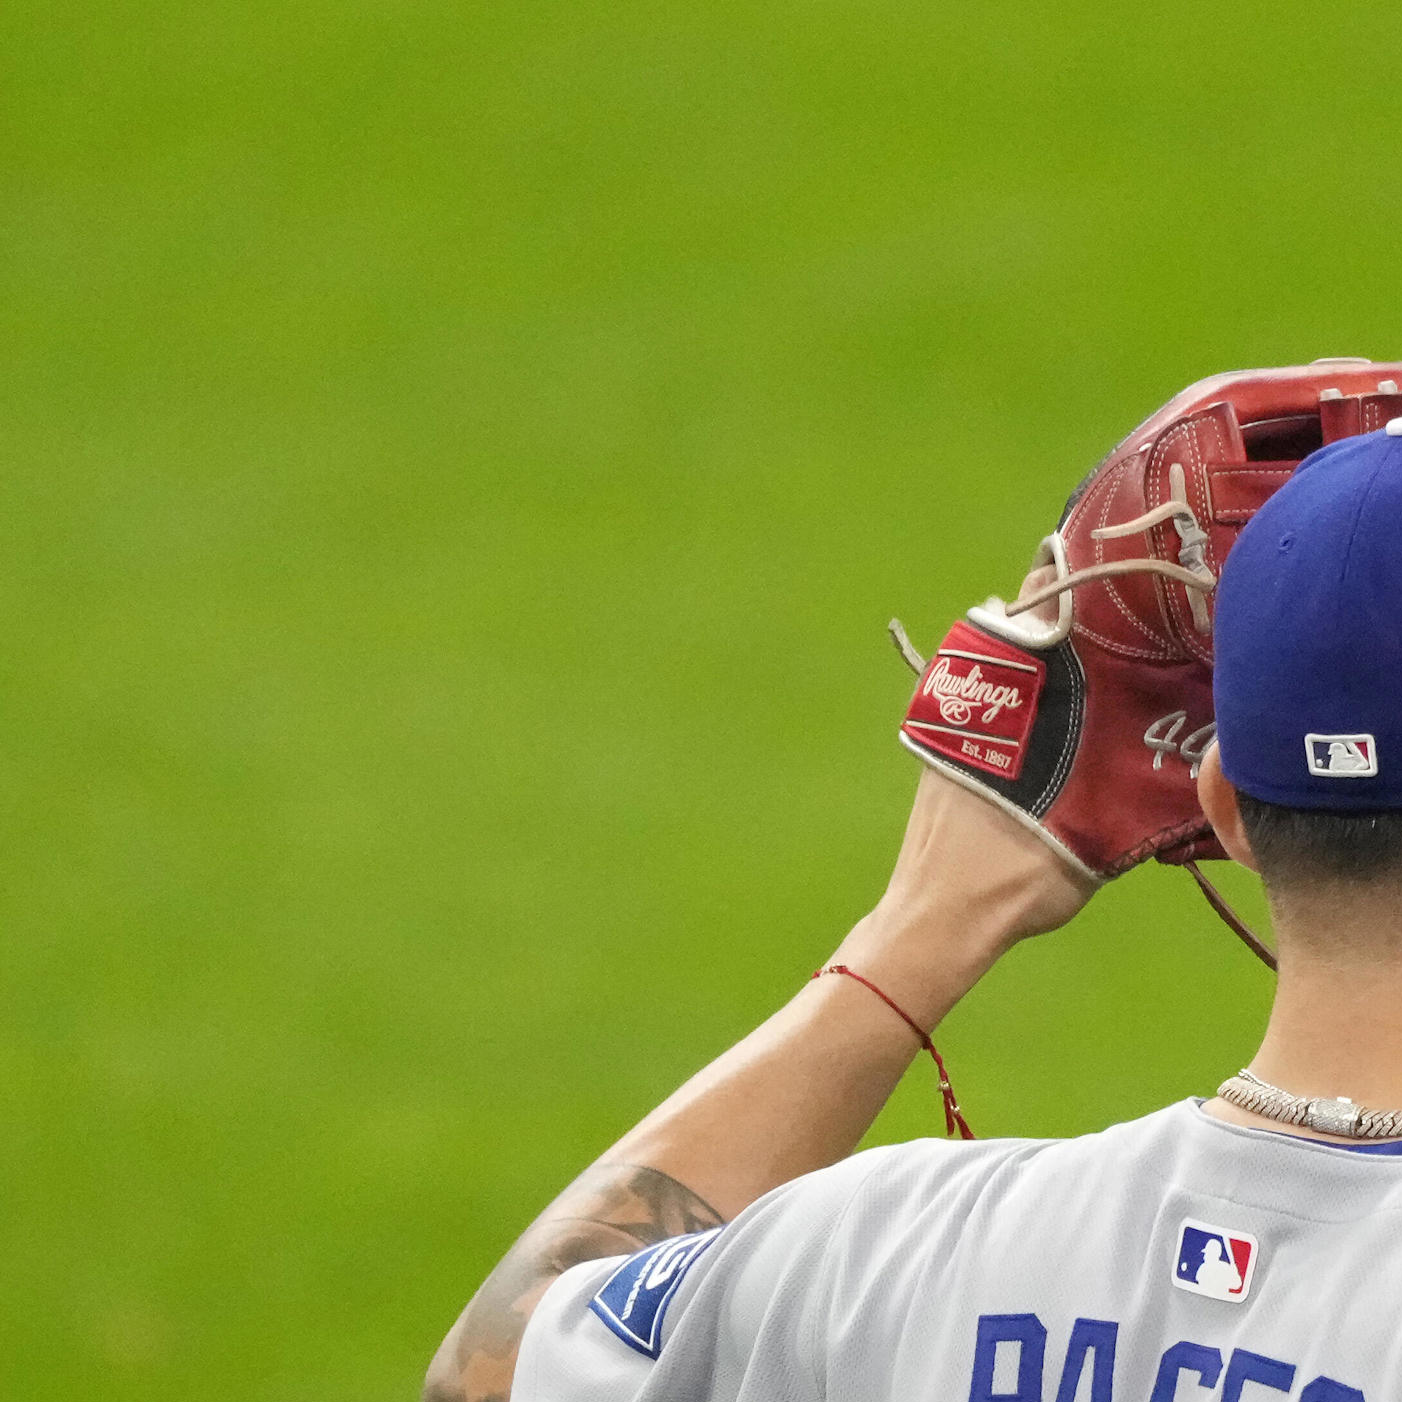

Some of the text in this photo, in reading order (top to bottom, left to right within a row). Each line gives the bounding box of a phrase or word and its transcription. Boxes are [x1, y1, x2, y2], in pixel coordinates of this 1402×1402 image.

[923, 657, 1022, 723] Rawlings
[961, 739, 1012, 769] Est. 1887
